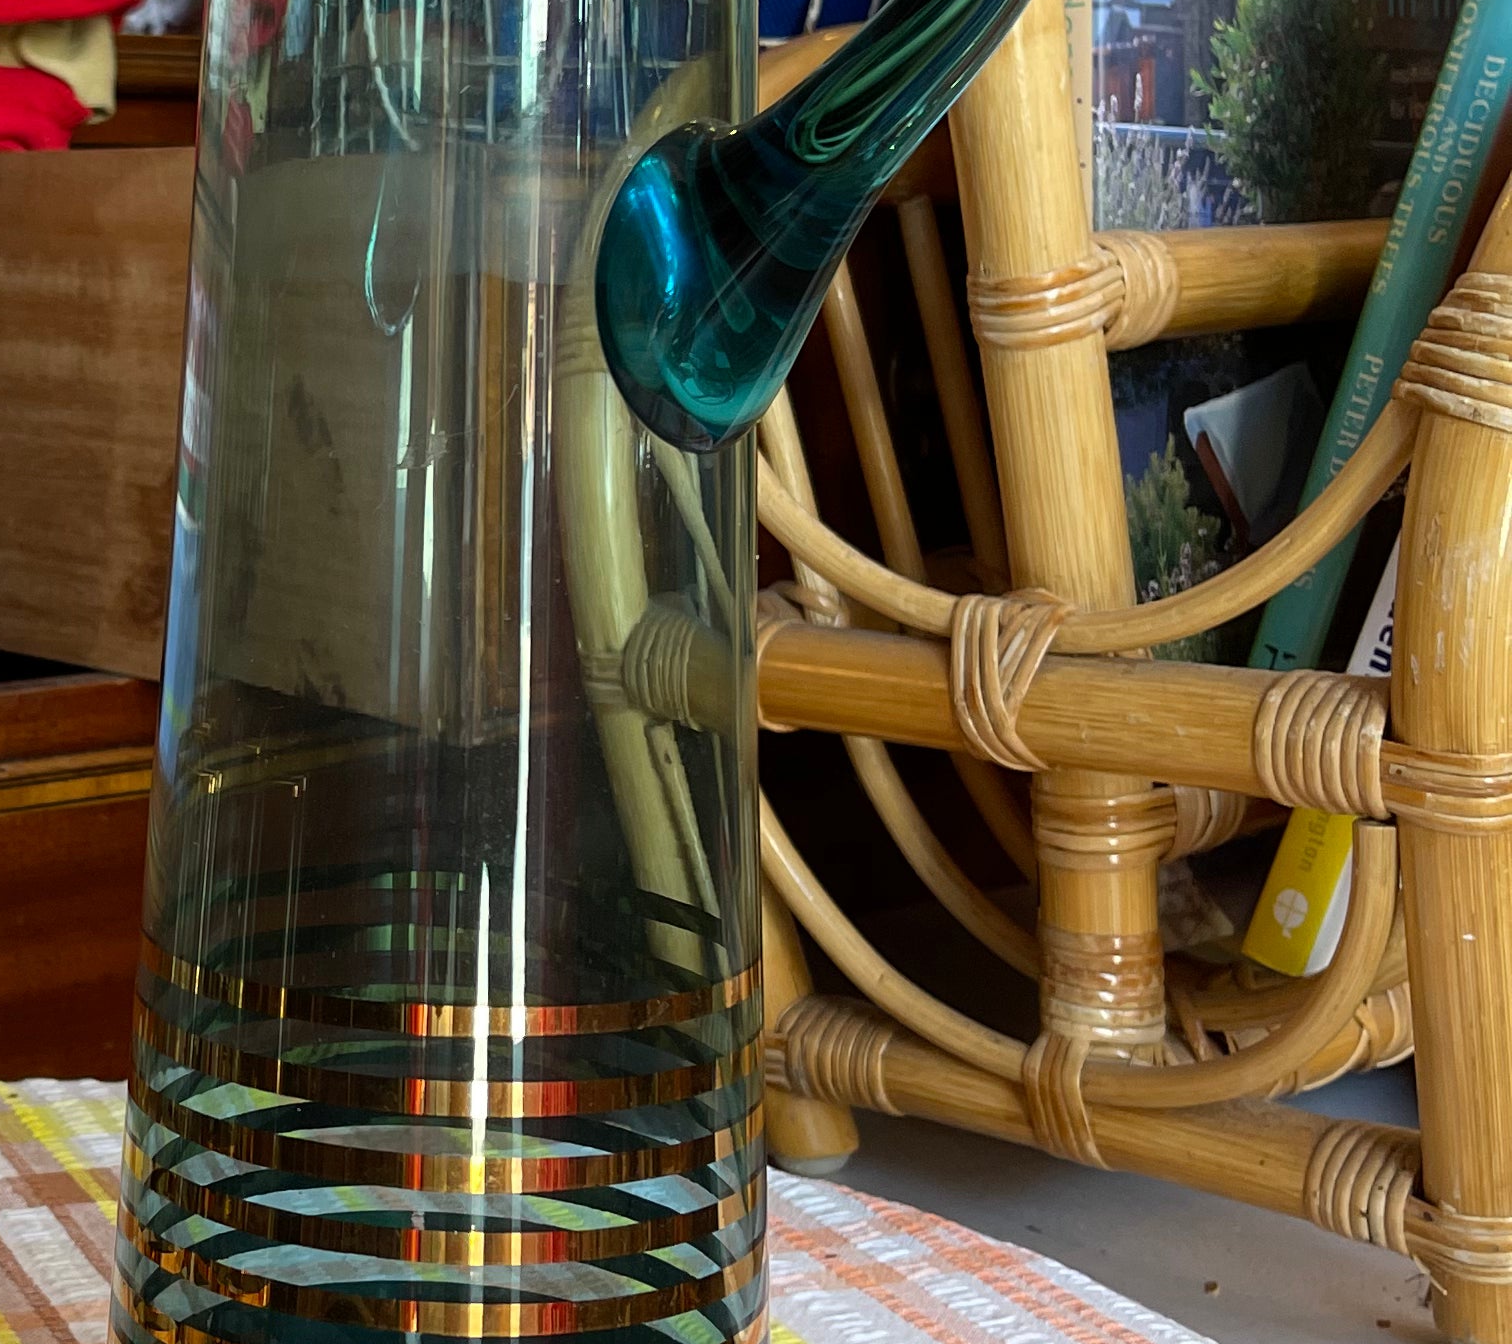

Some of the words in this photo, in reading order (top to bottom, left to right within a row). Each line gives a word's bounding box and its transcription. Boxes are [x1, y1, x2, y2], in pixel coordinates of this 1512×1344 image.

[1427, 54, 1507, 244] DECIDUOUS
[1431, 115, 1458, 174] AND
[1372, 197, 1414, 295] TREES
[1336, 352, 1384, 449] PETER
